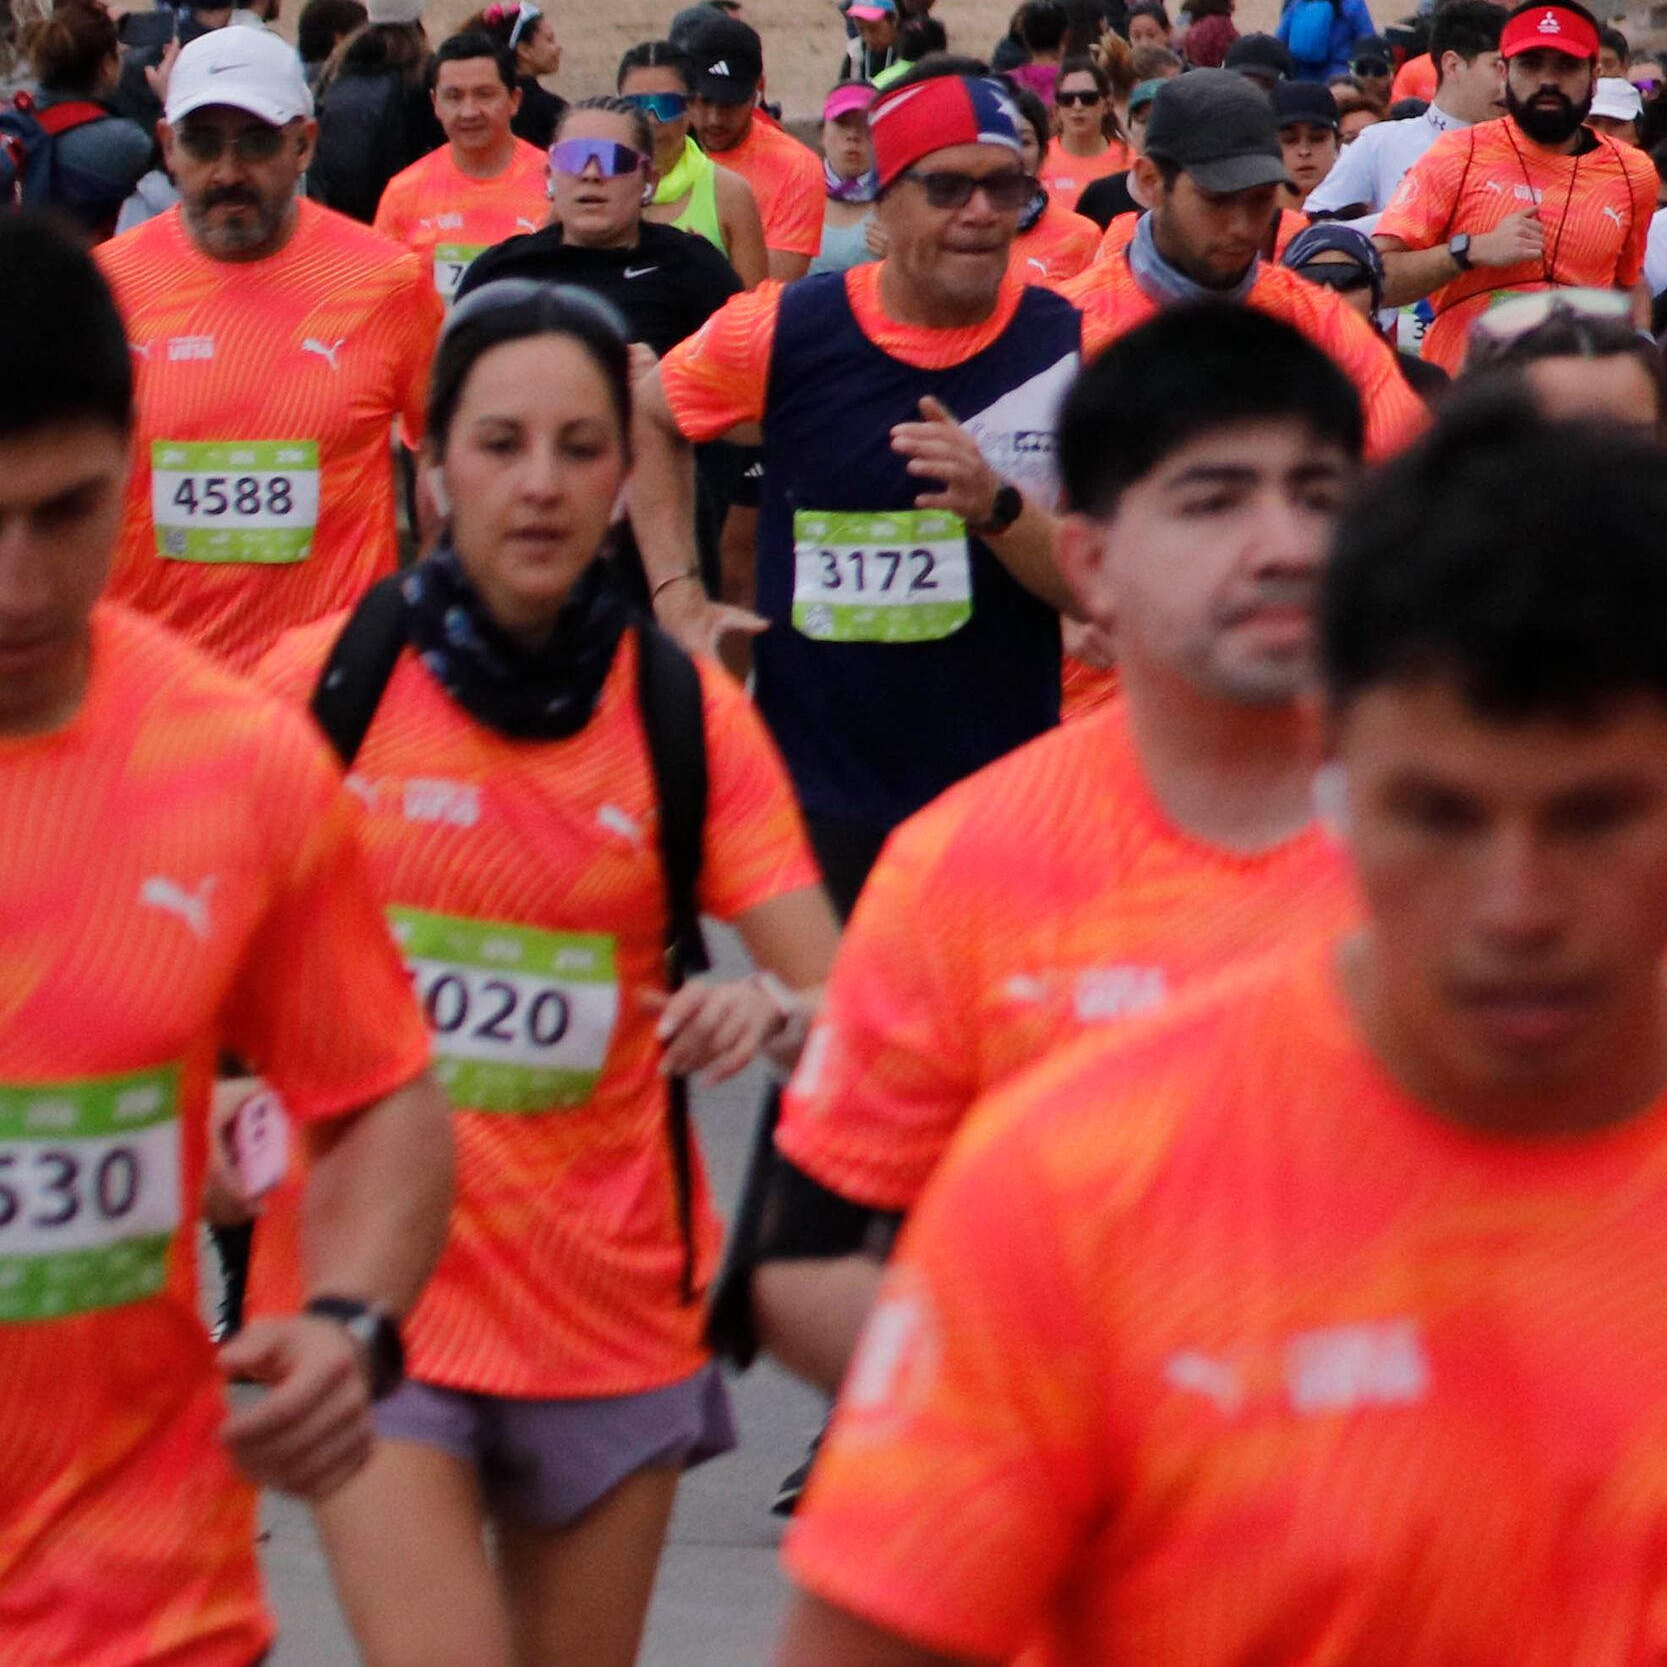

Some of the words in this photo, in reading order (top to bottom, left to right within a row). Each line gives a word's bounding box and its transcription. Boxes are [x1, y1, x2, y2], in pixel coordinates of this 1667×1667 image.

[173, 477, 293, 516] 4588
[818, 549, 940, 592] 3172
[412, 970, 571, 1048] 020
